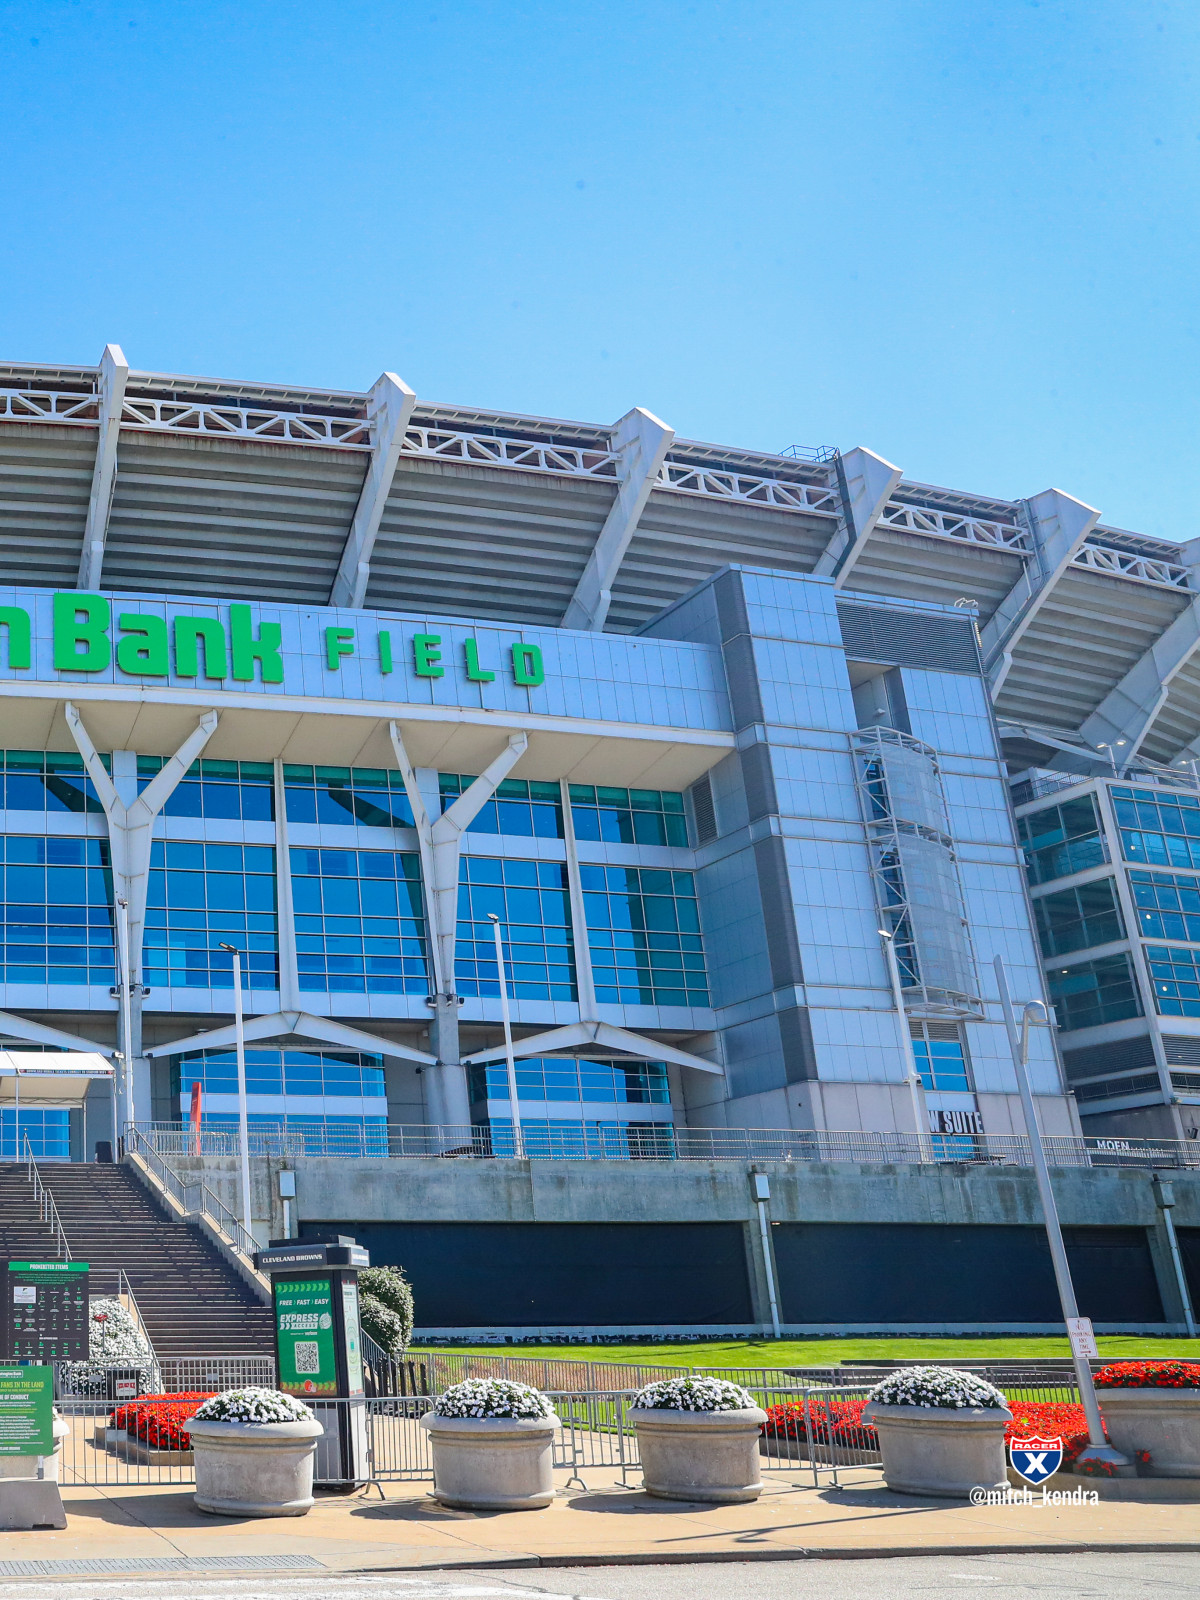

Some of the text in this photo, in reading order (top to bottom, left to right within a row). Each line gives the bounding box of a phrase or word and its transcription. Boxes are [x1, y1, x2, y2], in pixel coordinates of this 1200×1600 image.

[53, 592, 284, 683] Bank
[325, 626, 545, 686] FIELD
[262, 1253, 323, 1264] CLEVELAND BROWNS
[279, 1313, 319, 1323] EXPRESS
[0, 1381, 14, 1389] FANS
[21, 1381, 31, 1389] THE
[31, 1381, 44, 1389] LAND
